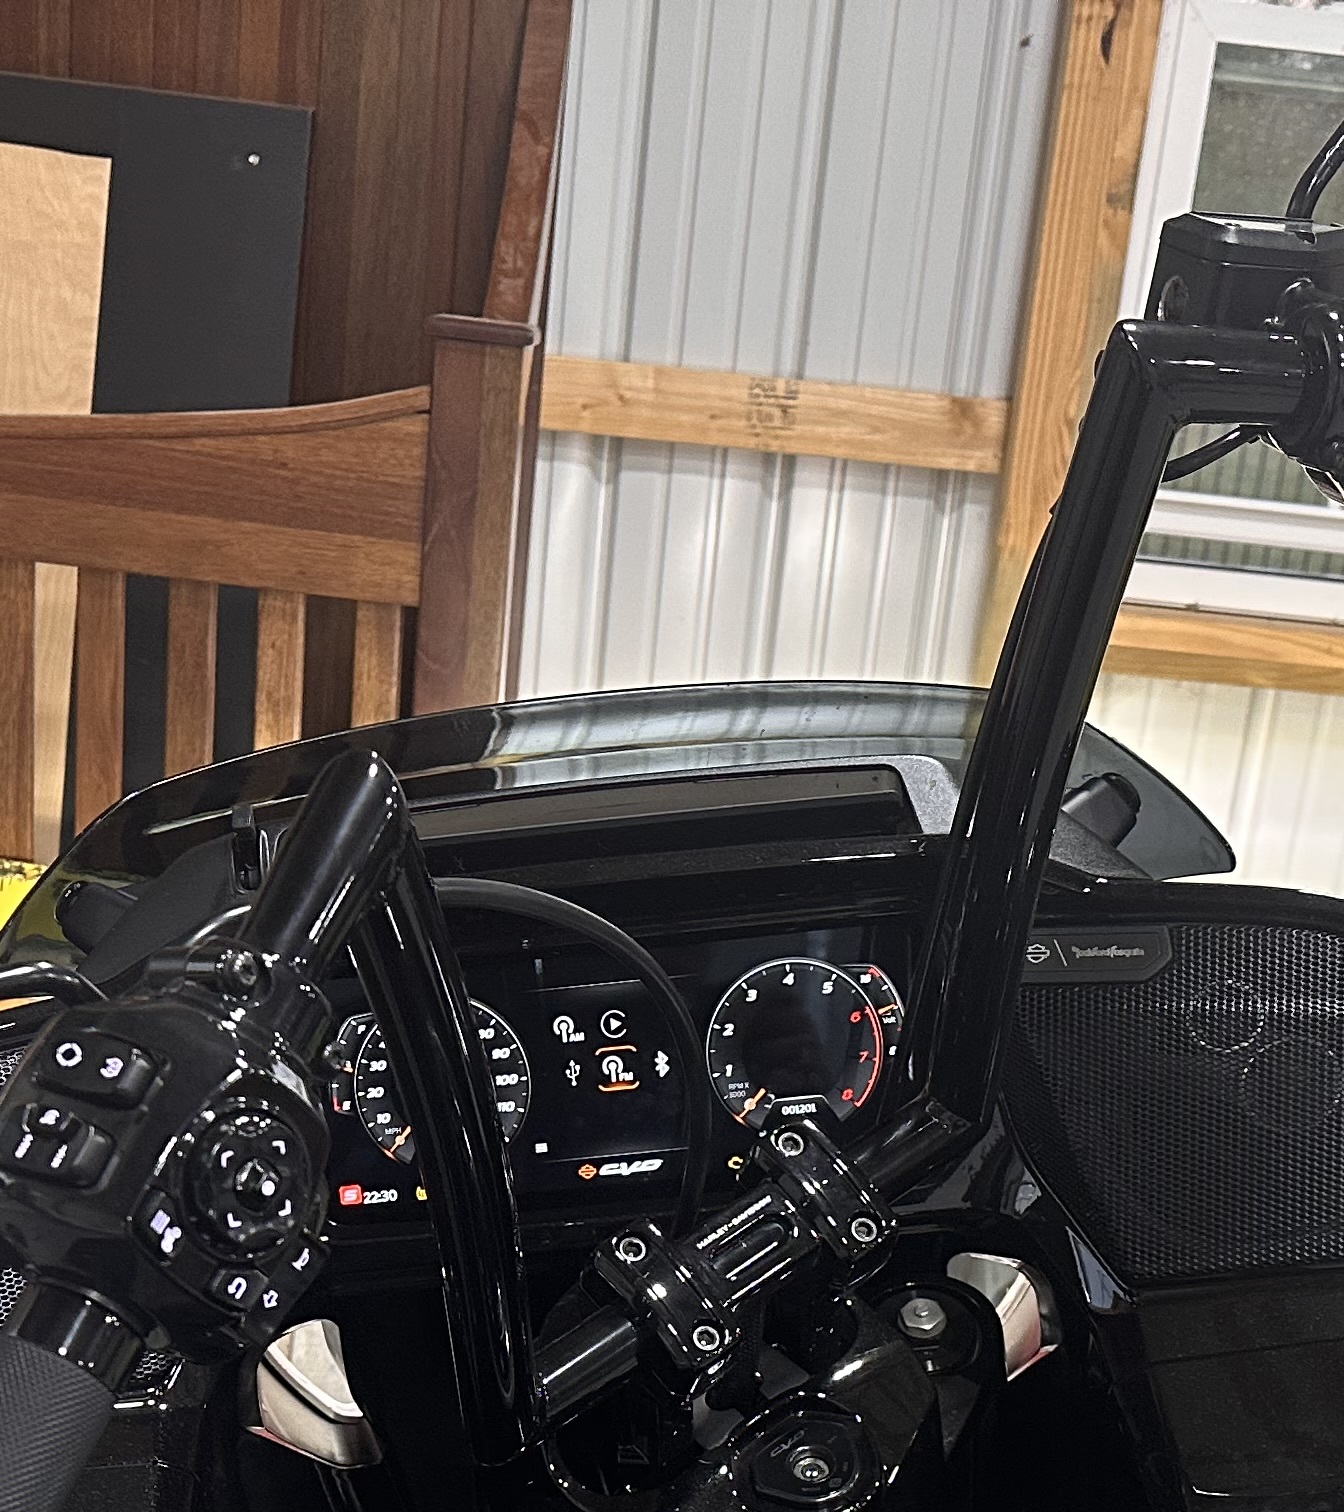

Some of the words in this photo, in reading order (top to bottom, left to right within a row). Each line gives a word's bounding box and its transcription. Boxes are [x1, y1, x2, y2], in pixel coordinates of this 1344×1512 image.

[782, 973, 795, 986] 4
[822, 981, 834, 995] 5
[746, 989, 758, 1002] 3
[850, 1011, 862, 1023] 6
[722, 1023, 735, 1037] 2
[569, 1032, 585, 1042] AM
[859, 1051, 869, 1063] 7
[369, 1060, 387, 1072] 30
[496, 1073, 519, 1086] 100
[366, 1087, 385, 1099] 20
[497, 1101, 516, 1113] 110
[376, 1112, 391, 1125] 10
[599, 1159, 664, 1176] CVO
[363, 1188, 398, 1205] 22:30
